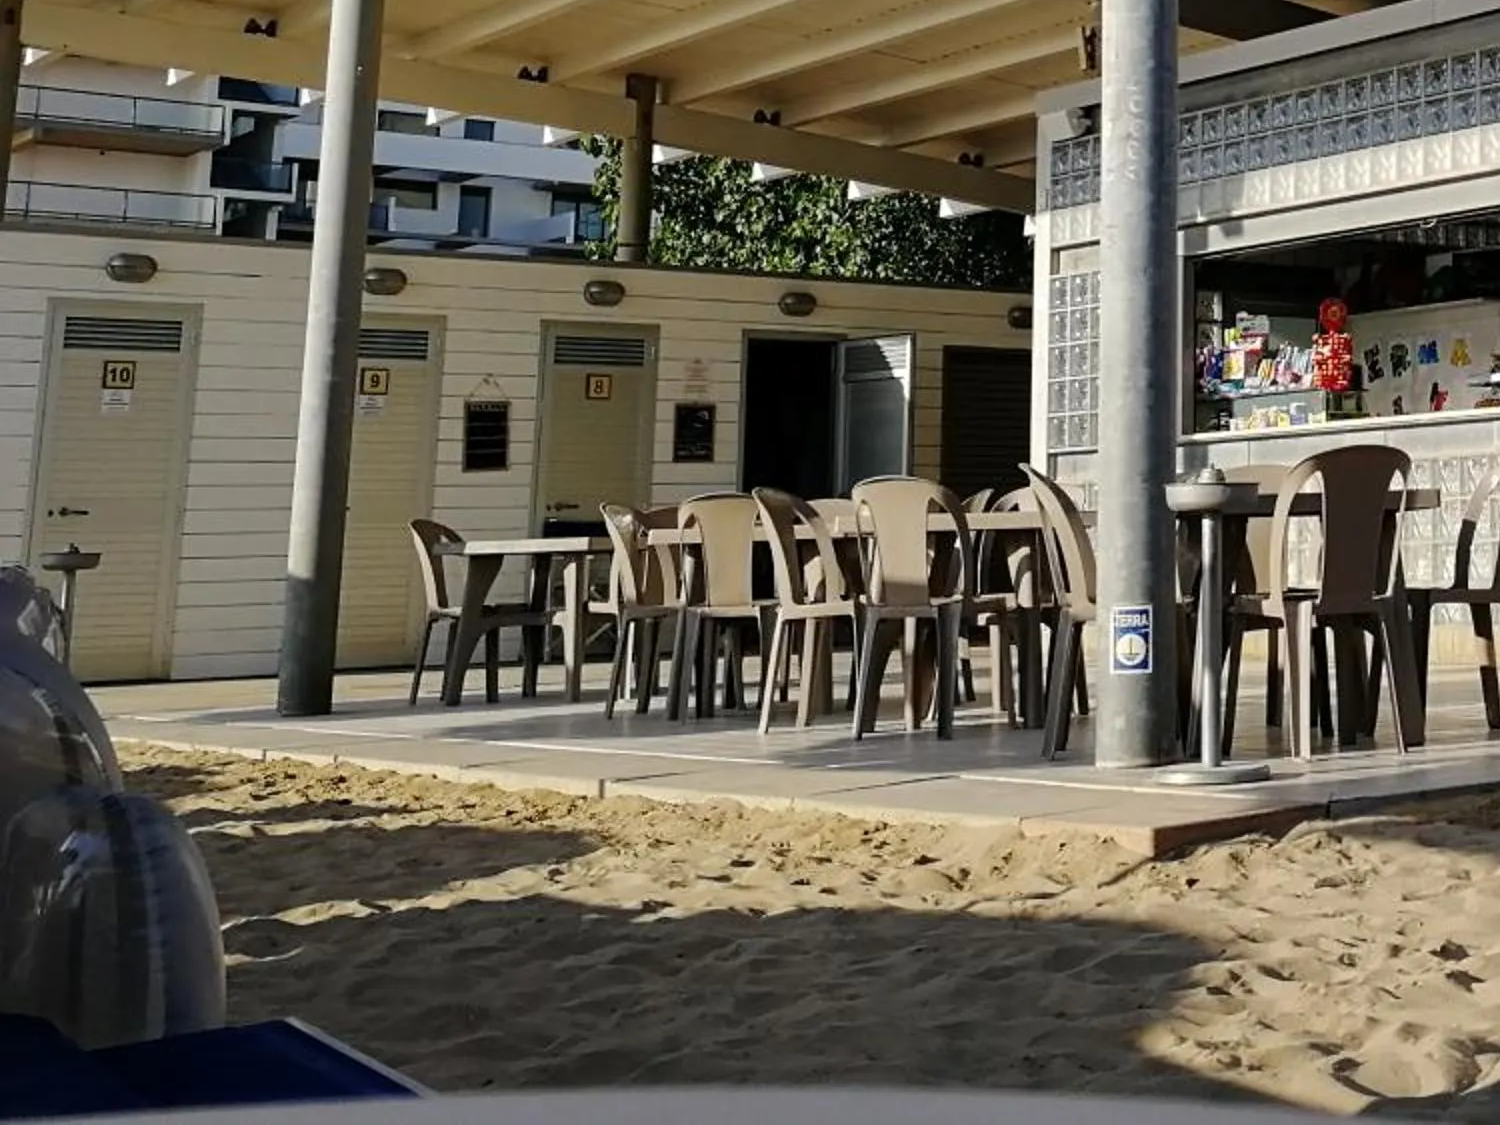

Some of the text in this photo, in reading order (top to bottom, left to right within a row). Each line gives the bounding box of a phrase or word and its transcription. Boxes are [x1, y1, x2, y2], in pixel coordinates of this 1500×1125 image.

[108, 366, 131, 383] 10
[369, 373, 381, 388] 9
[593, 379, 605, 394] 8
